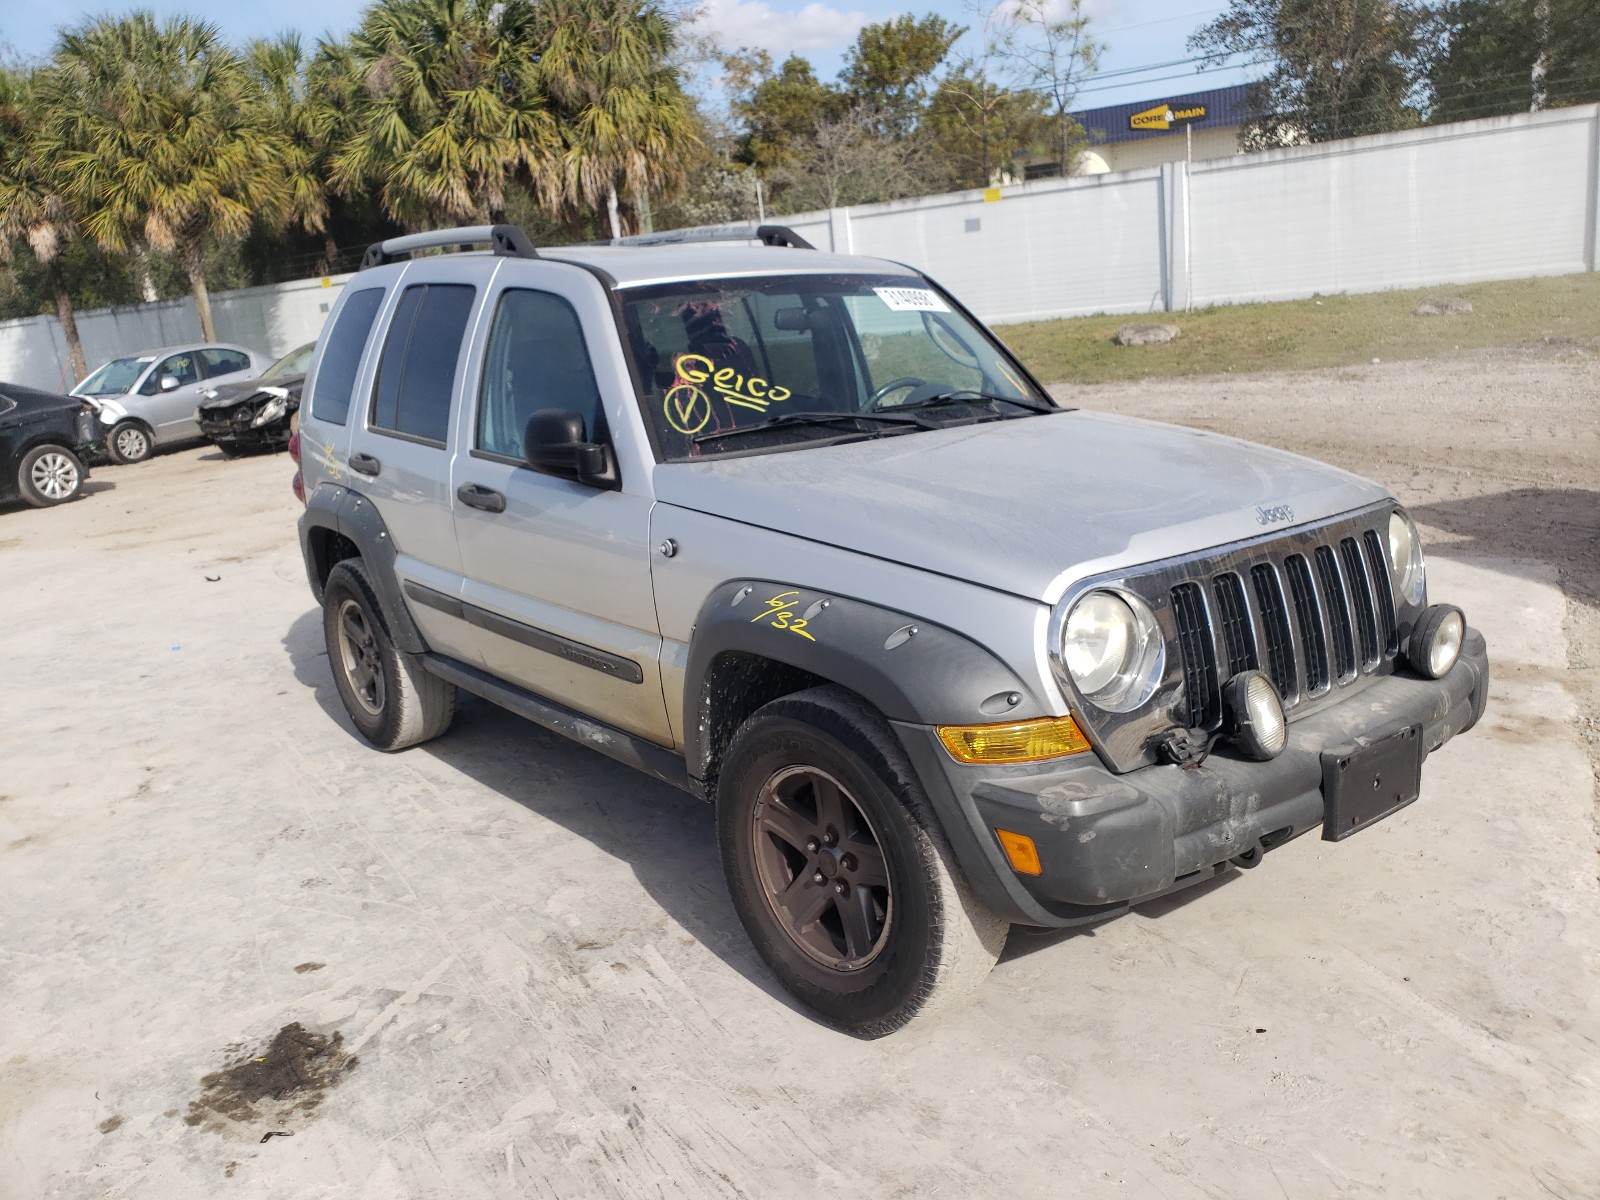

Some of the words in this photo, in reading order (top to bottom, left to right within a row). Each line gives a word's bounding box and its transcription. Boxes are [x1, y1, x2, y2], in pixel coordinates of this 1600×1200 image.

[1133, 114, 1165, 125] CORE
[1174, 107, 1205, 119] MAIN
[1254, 505, 1294, 525] Jeep
